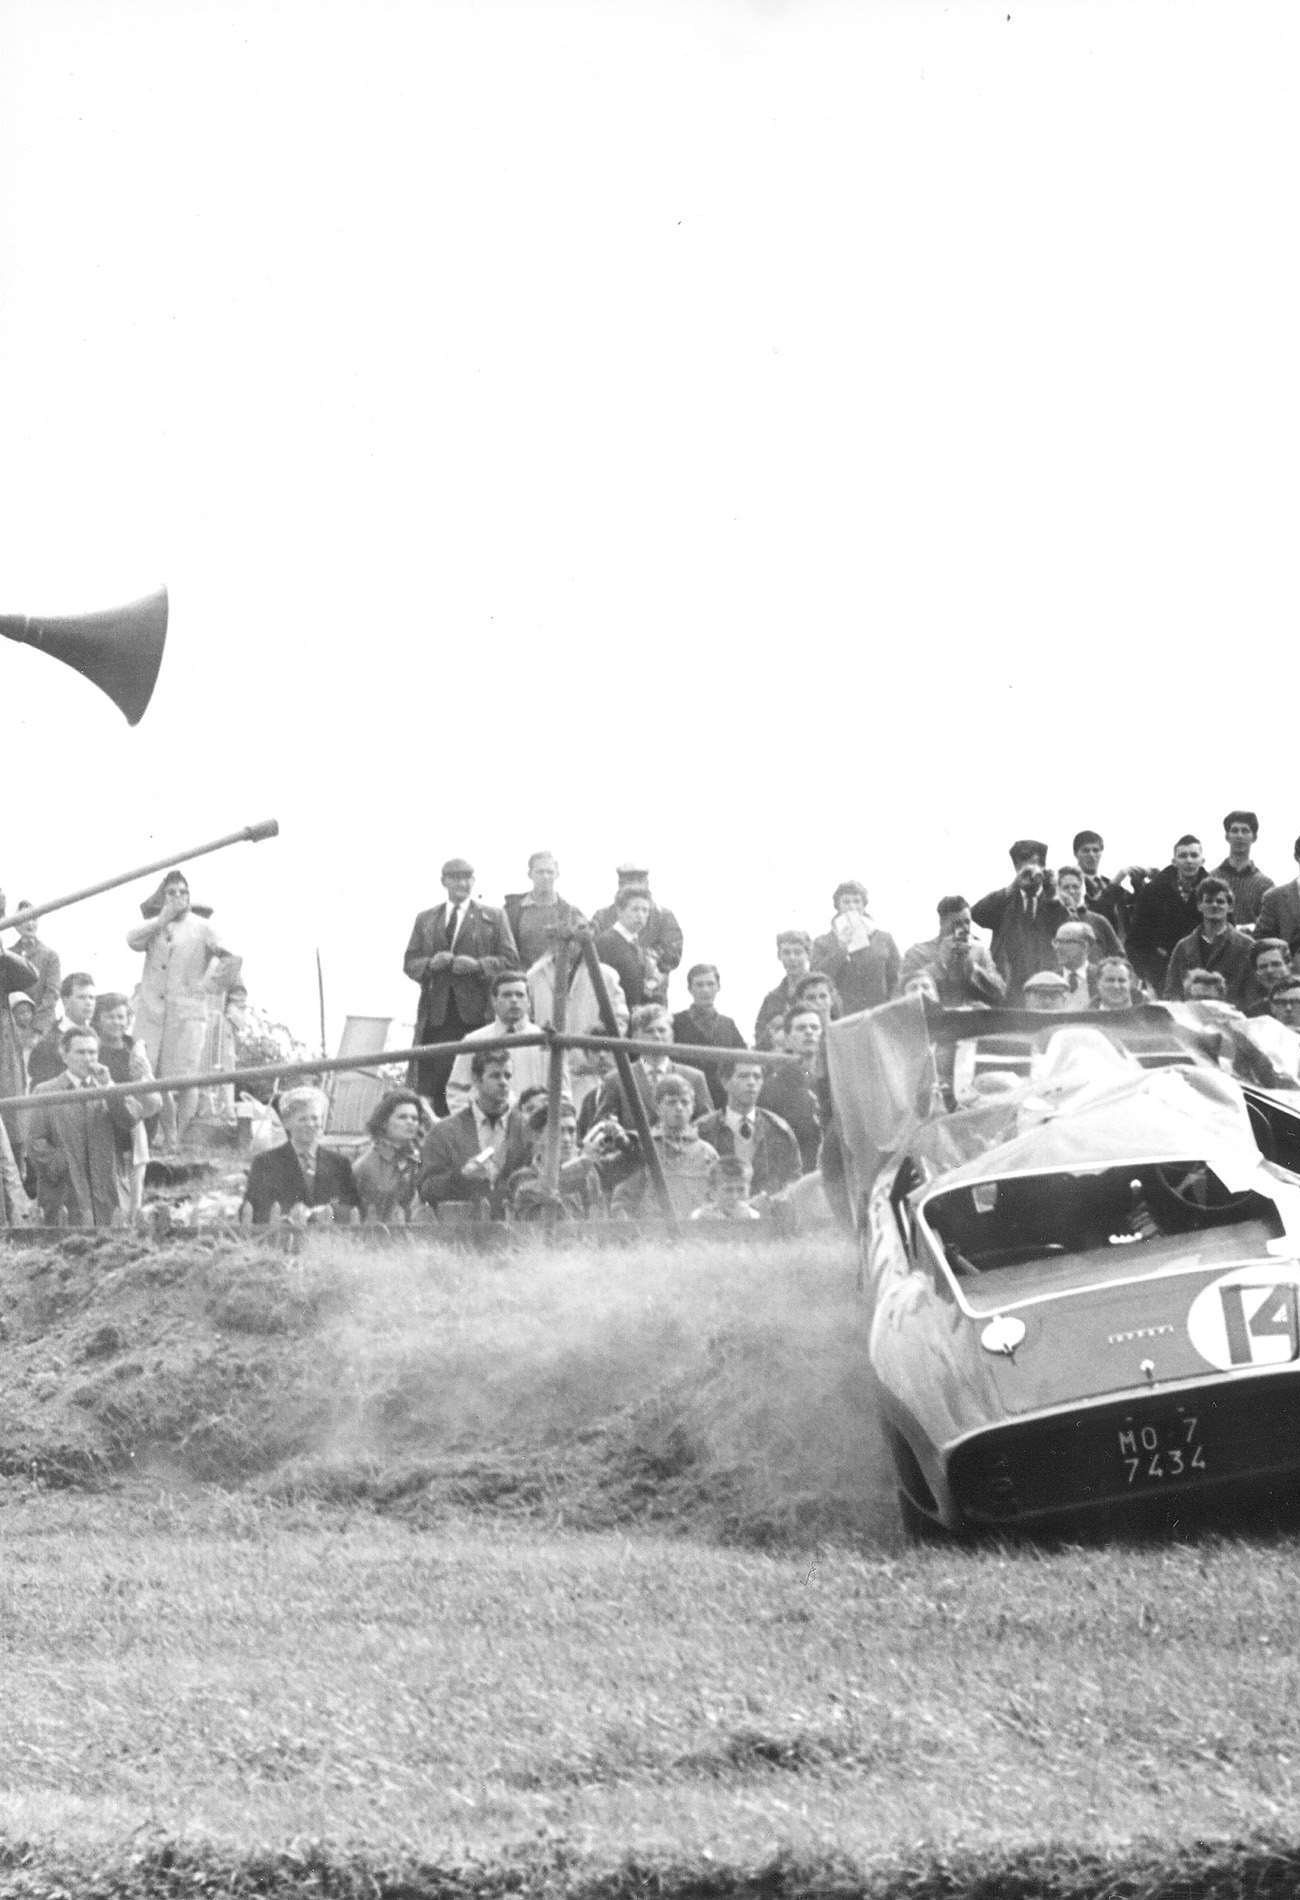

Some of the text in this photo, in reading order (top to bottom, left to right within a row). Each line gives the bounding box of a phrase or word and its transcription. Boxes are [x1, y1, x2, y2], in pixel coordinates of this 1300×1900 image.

[1119, 1418, 1198, 1455] MO 7
[1124, 1446, 1206, 1482] 7434
